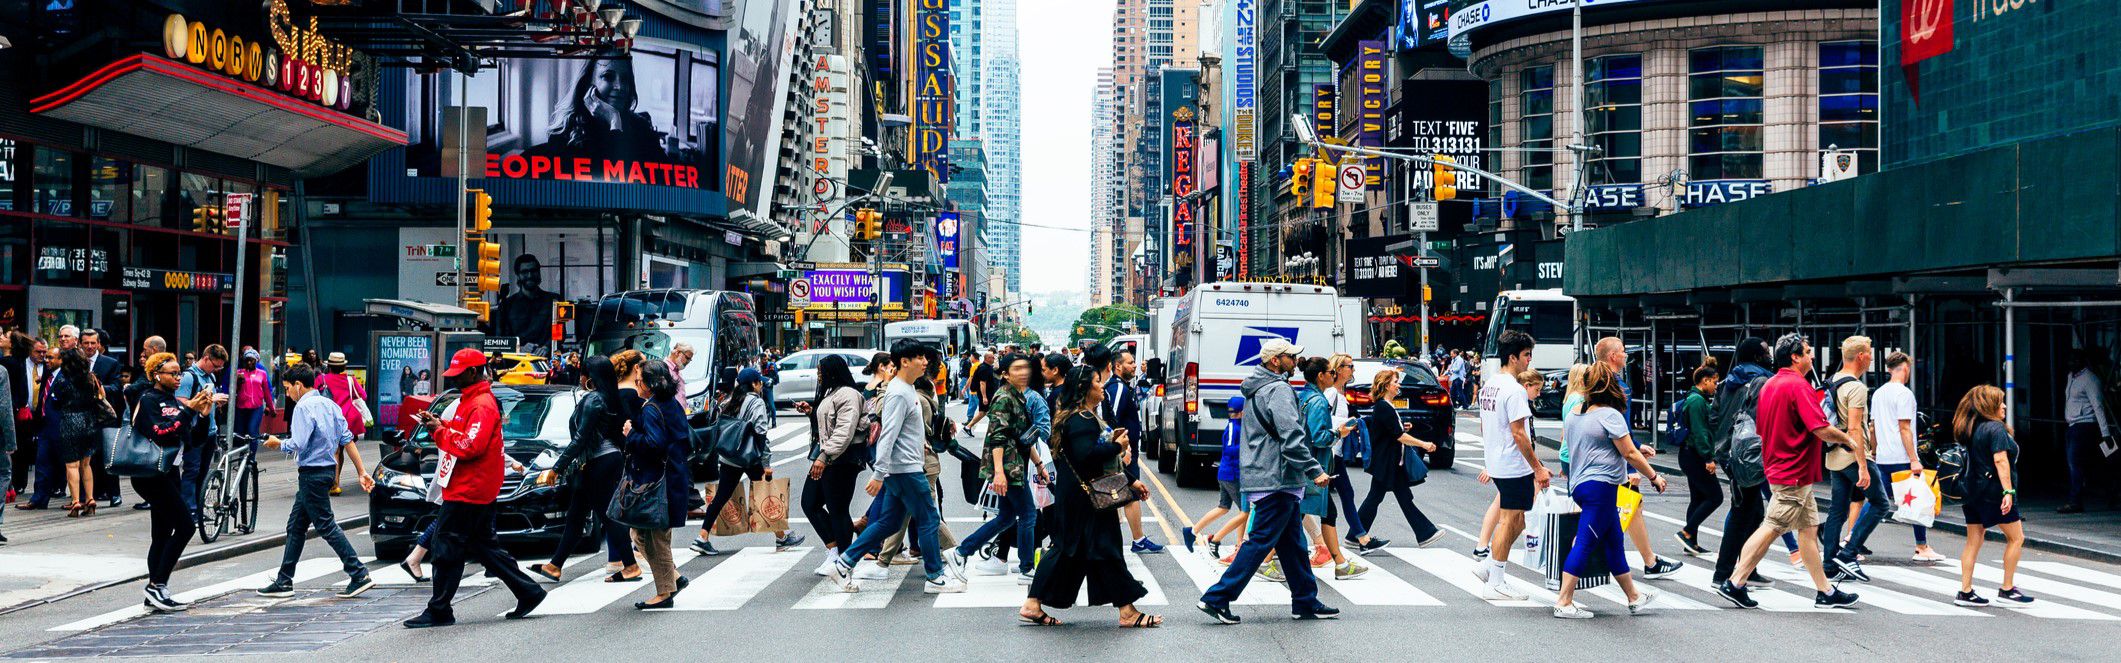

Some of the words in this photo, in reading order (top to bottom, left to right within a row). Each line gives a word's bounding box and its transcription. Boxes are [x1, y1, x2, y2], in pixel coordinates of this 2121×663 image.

[1457, 9, 1481, 29] CHASE
[196, 30, 205, 56] N
[215, 36, 224, 63] Q
[233, 45, 243, 69] R
[250, 53, 262, 77] W
[268, 56, 276, 80] S
[285, 61, 291, 85] 1
[300, 68, 307, 91] 2
[314, 72, 321, 96] 3
[343, 82, 350, 104] 7
[1237, 47, 1254, 107] STUDIOS
[1364, 46, 1381, 132] VICTORY
[1237, 115, 1253, 150] DUKE
[1413, 121, 1442, 134] TEXT
[813, 55, 831, 235] AMSTERDAM
[1413, 137, 1429, 153] TO
[1432, 137, 1480, 153] 313131
[486, 153, 592, 181] EOPLE
[603, 158, 698, 188] MATTER
[1413, 171, 1433, 189] AD
[1174, 126, 1192, 246] REGAL
[123, 278, 137, 287] Subway
[137, 279, 150, 287] Station
[814, 286, 831, 297] YOU
[833, 286, 856, 297] WISH
[1215, 298, 1249, 308] 6424740
[381, 336, 406, 347] NEVER
[407, 336, 427, 347] BEEN
